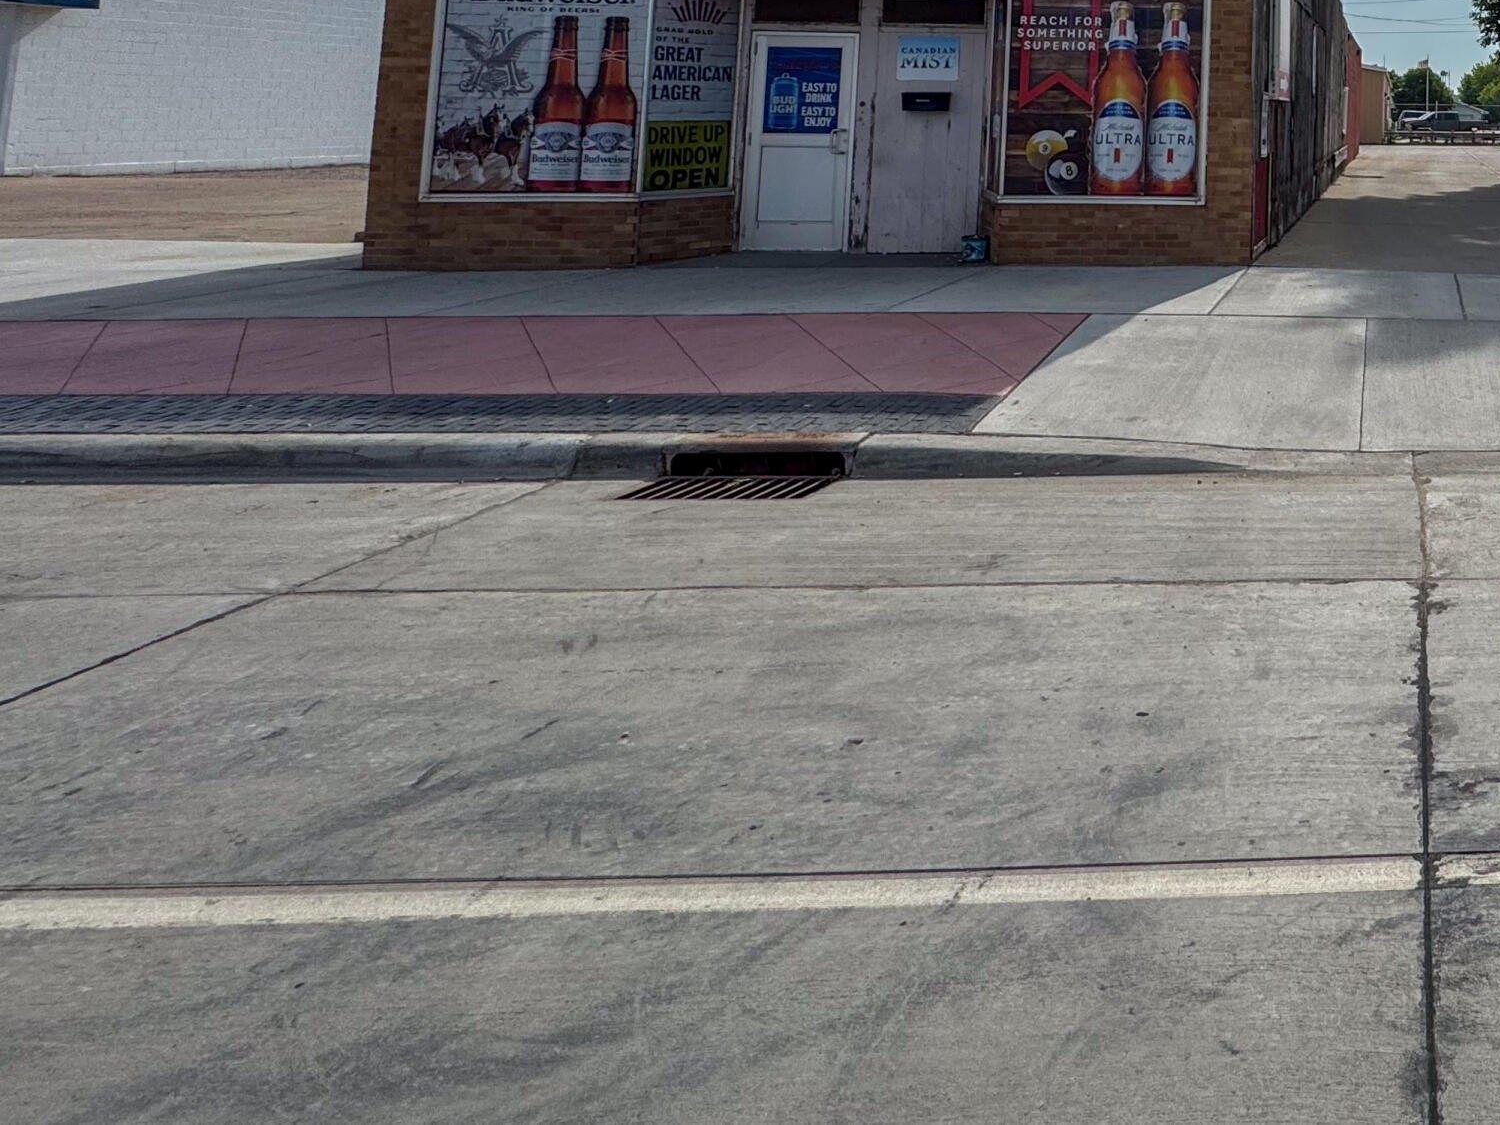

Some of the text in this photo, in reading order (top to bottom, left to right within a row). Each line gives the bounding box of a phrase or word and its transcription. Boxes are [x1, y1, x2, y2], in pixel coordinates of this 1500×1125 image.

[1020, 15, 1102, 26] REACH FOR
[1017, 28, 1104, 38] SOMETHING
[1023, 41, 1096, 51] SUPERIOR
[654, 45, 704, 62] GREAT
[900, 55, 952, 69] MIST
[652, 65, 732, 82] AMERICAN
[651, 84, 701, 101] LAGER
[802, 82, 837, 92] EASY TO
[805, 93, 832, 103] DRINK
[801, 106, 836, 116] EASY TO
[804, 117, 832, 127] ENJOY
[648, 125, 725, 145] DRIVE UP
[1095, 133, 1142, 145] ULTRA
[1148, 133, 1195, 145] ULTRA
[650, 146, 722, 167] WINDOW
[1065, 165, 1073, 176] 8
[649, 167, 719, 190] OPEN
